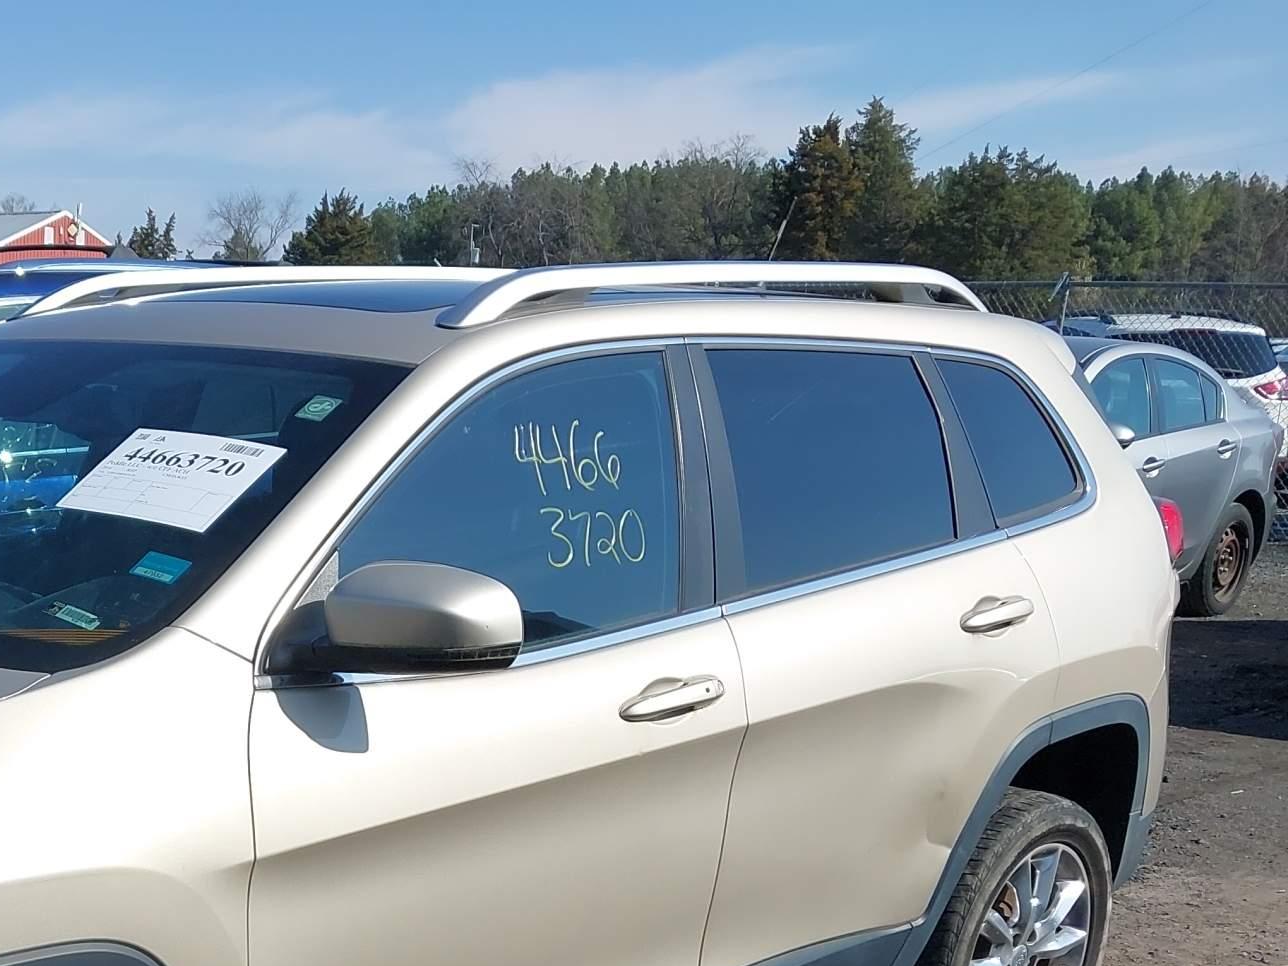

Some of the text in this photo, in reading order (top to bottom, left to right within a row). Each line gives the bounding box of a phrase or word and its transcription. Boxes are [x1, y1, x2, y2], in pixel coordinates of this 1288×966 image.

[123, 446, 246, 477] 44663720
[514, 419, 621, 496] 4466
[539, 507, 646, 568] 3720
